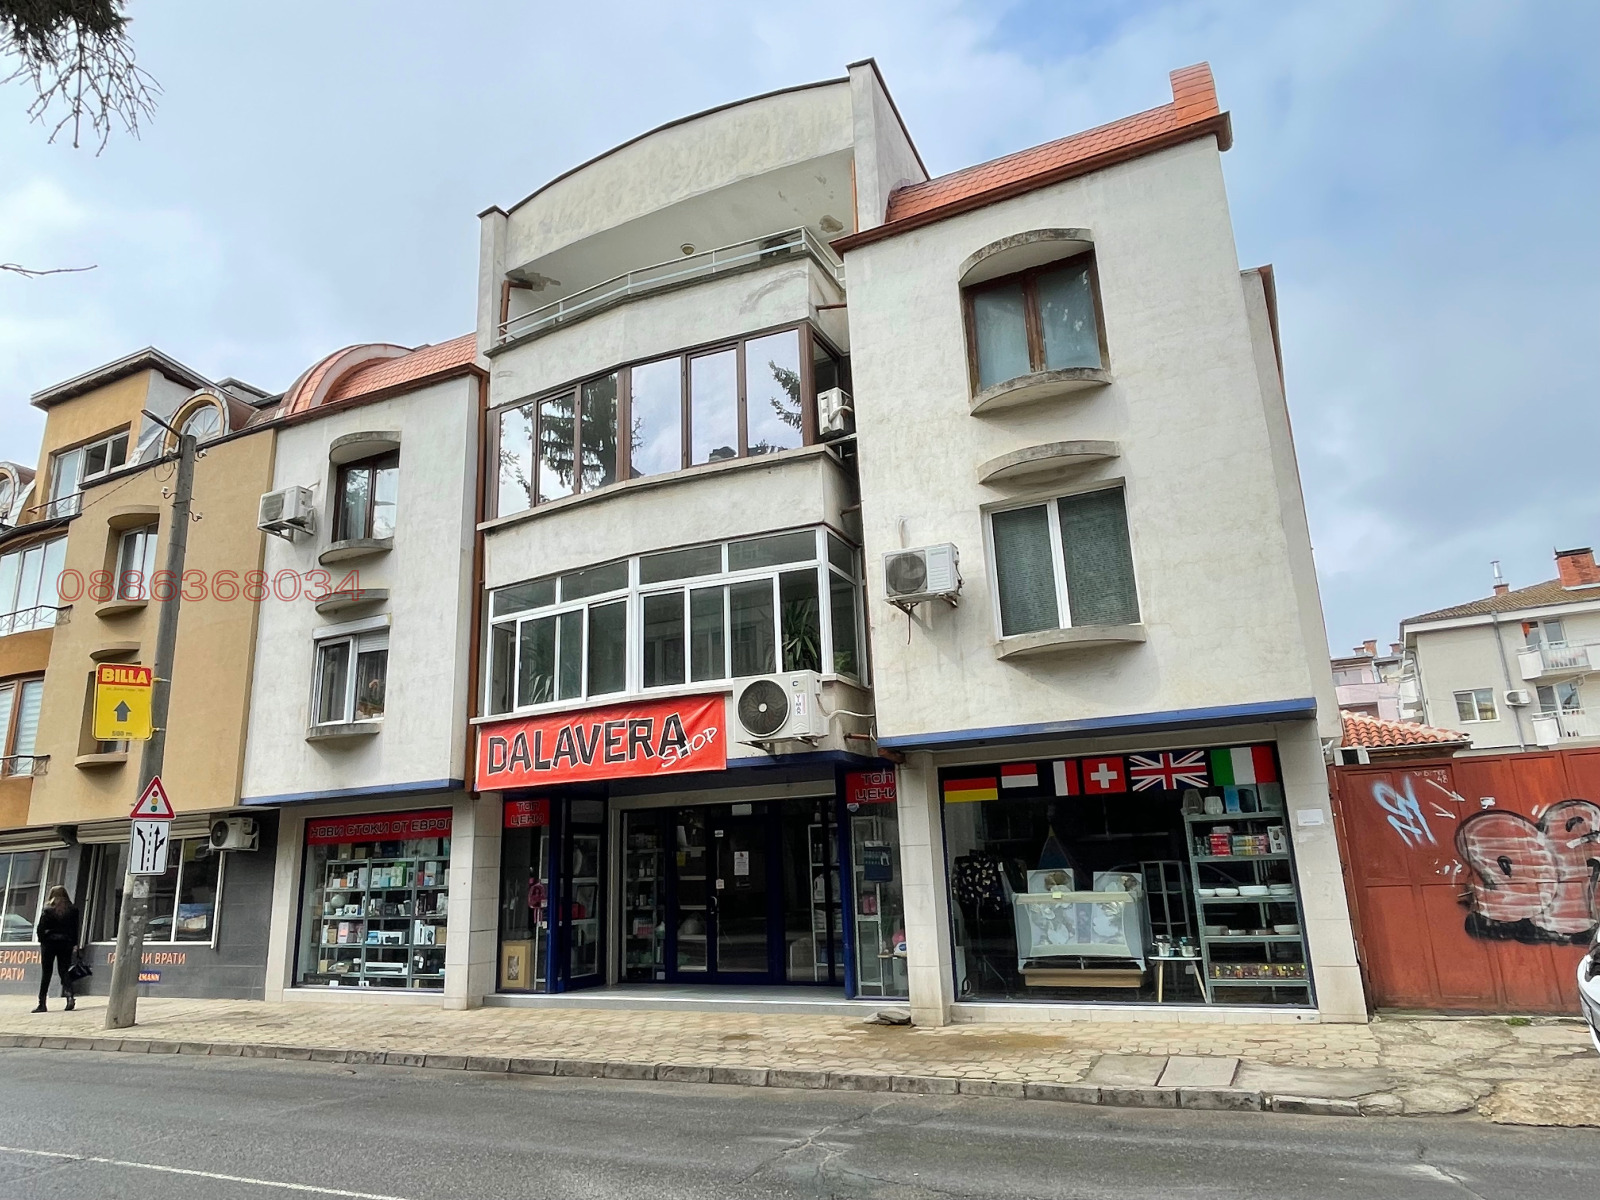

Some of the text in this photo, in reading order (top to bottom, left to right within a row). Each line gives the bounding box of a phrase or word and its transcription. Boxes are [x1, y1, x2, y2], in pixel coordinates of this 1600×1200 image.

[101, 668, 148, 684] BILLA
[487, 711, 718, 777] DALAVERA SHOP
[861, 771, 894, 785] ТОП
[855, 787, 897, 802] ЦЕНИ
[516, 801, 540, 812] ТОП
[511, 814, 544, 827] ЦЕНИ
[310, 825, 343, 838] НОВИ
[346, 821, 389, 836] СТОКИ
[392, 821, 409, 832] ОТ
[155, 952, 186, 966] ВРАТИ
